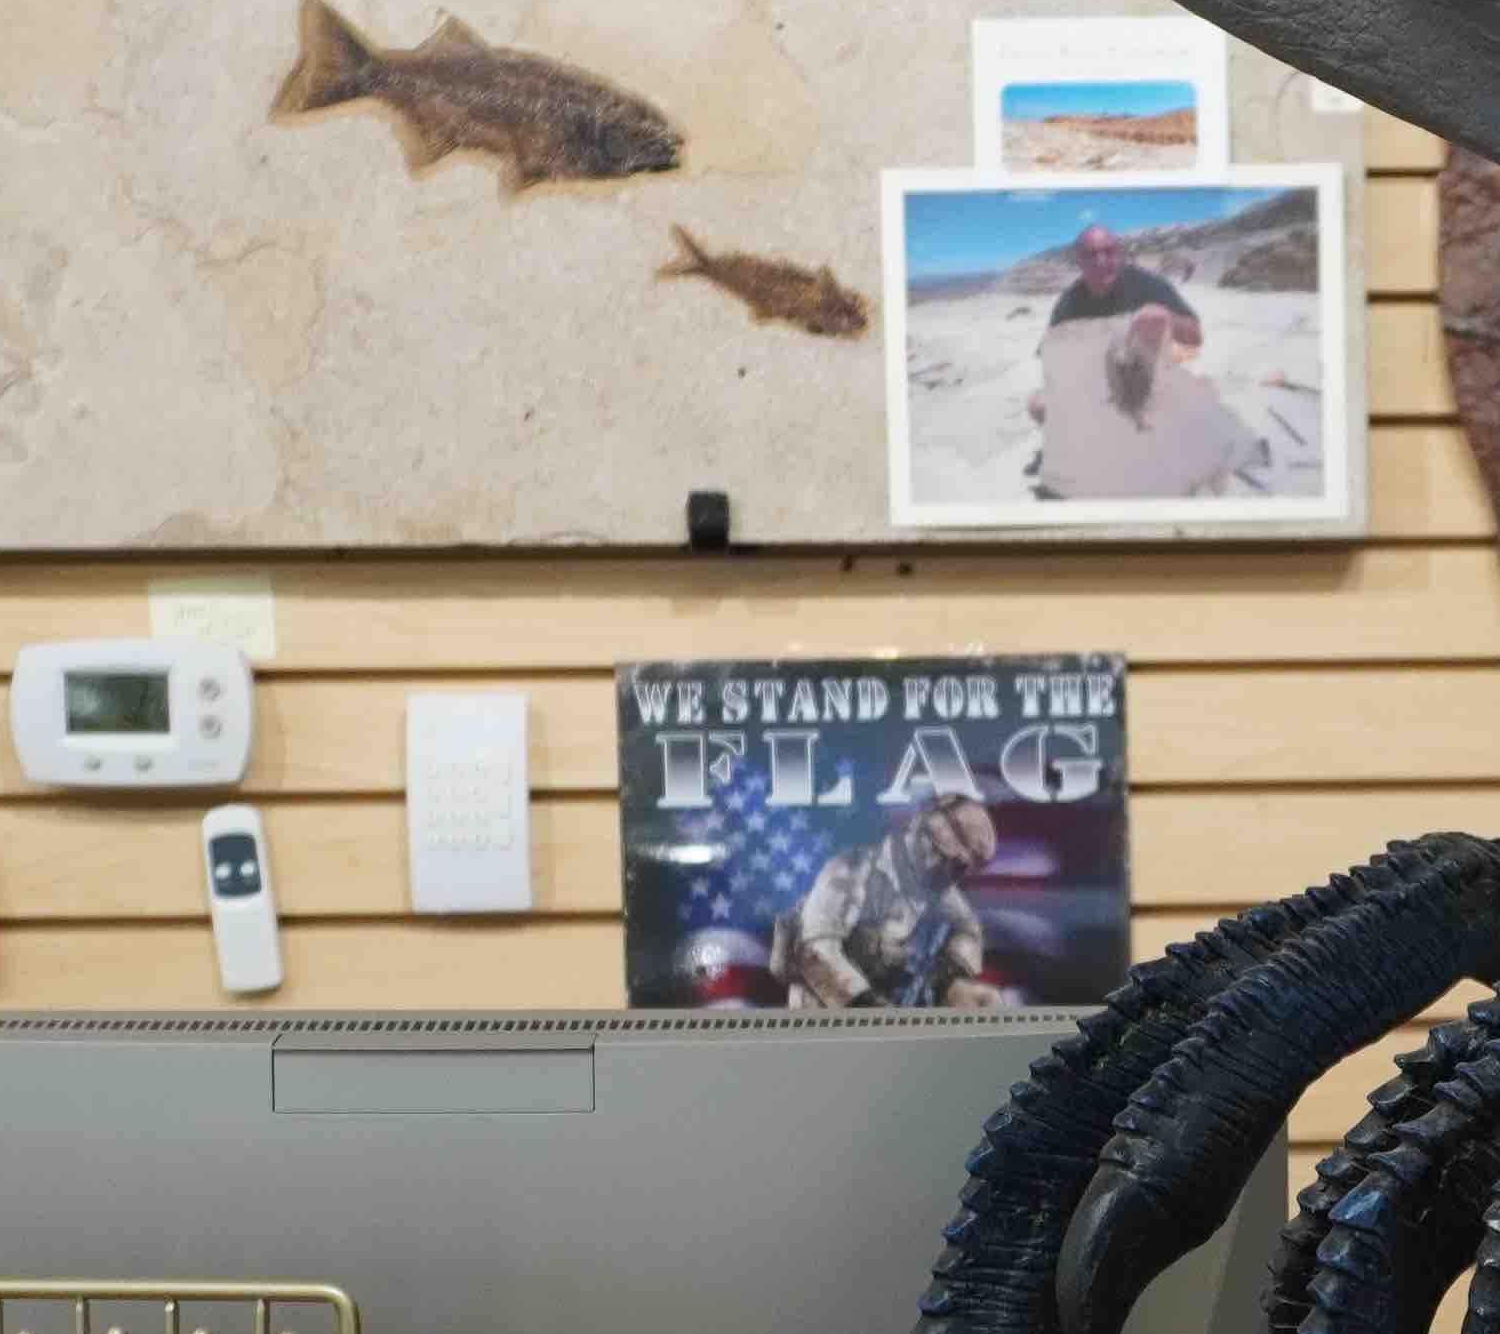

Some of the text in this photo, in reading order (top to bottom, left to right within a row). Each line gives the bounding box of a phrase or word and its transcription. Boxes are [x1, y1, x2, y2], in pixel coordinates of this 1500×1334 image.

[633, 672, 1117, 725] WE STAND FOR THE
[655, 724, 1102, 809] FLAG
